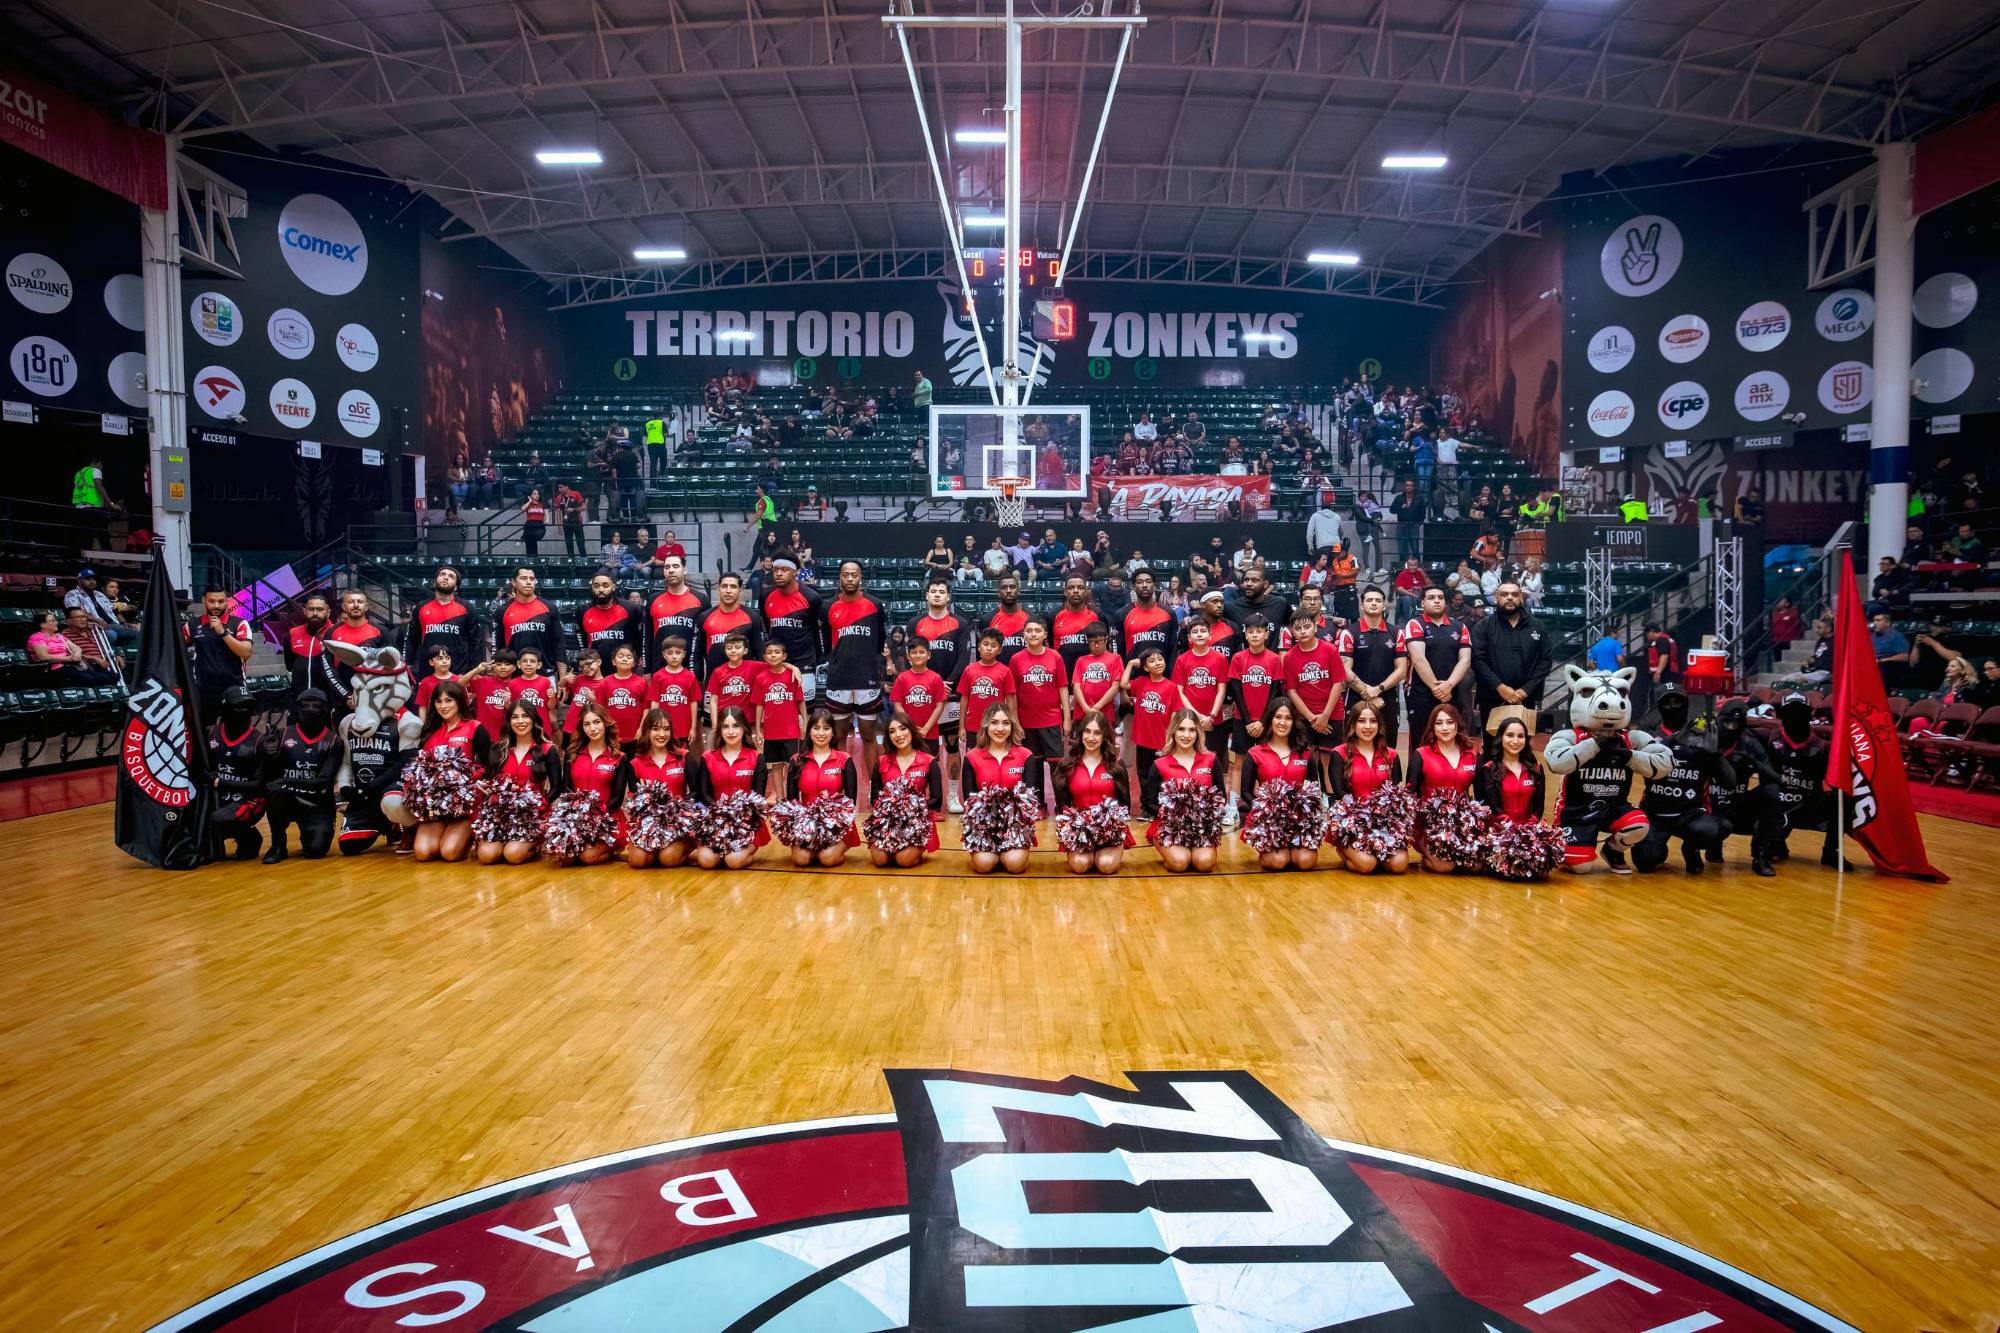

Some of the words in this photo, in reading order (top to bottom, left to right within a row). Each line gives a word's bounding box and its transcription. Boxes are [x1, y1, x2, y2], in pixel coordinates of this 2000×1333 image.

[285, 228, 360, 262] Comex
[9, 273, 69, 297] SPALDING
[625, 310, 914, 358] TERRITORIO
[1740, 322, 1786, 338] 107.3
[1823, 321, 1867, 335] MEGA
[1087, 311, 1299, 359] ZONKEYS
[275, 403, 310, 418] TECATE
[348, 402, 371, 416] abc
[1668, 398, 1705, 419] cpe
[202, 432, 228, 444] ACCESO
[228, 435, 237, 446] 01
[1744, 436, 1771, 448] ACCESO
[1772, 436, 1782, 445] 02
[1736, 470, 1871, 504] ZONKEY
[510, 621, 546, 635] ZONKEYS
[658, 616, 693, 628] ZONKEYS
[770, 618, 803, 628] ZONKEYS
[425, 623, 460, 635] ZONKEYS
[838, 625, 871, 638] ZONKEYS
[590, 630, 625, 642] ZONKEYS
[1060, 633, 1088, 645] ZONKE
[1132, 631, 1166, 643] ZONKEYS
[929, 640, 954, 652] NKEYS
[1023, 673, 1053, 683] ZONKEYS
[1082, 670, 1111, 681] ZONKEYS
[1187, 676, 1216, 686] ZONKEYS
[1242, 674, 1272, 685] ZONKEYS
[1298, 669, 1330, 683] ZONKEYS
[722, 684, 750, 694] ZONKEYS
[971, 685, 999, 697] ZONKEYS
[608, 694, 636, 707] ZONKEYS
[660, 693, 688, 705] ZONKEYS
[765, 691, 793, 702] ZONKEYS
[905, 693, 932, 705] ZONKEYS
[1578, 767, 1627, 781] TIJUANA
[1650, 784, 1683, 798] ARCO
